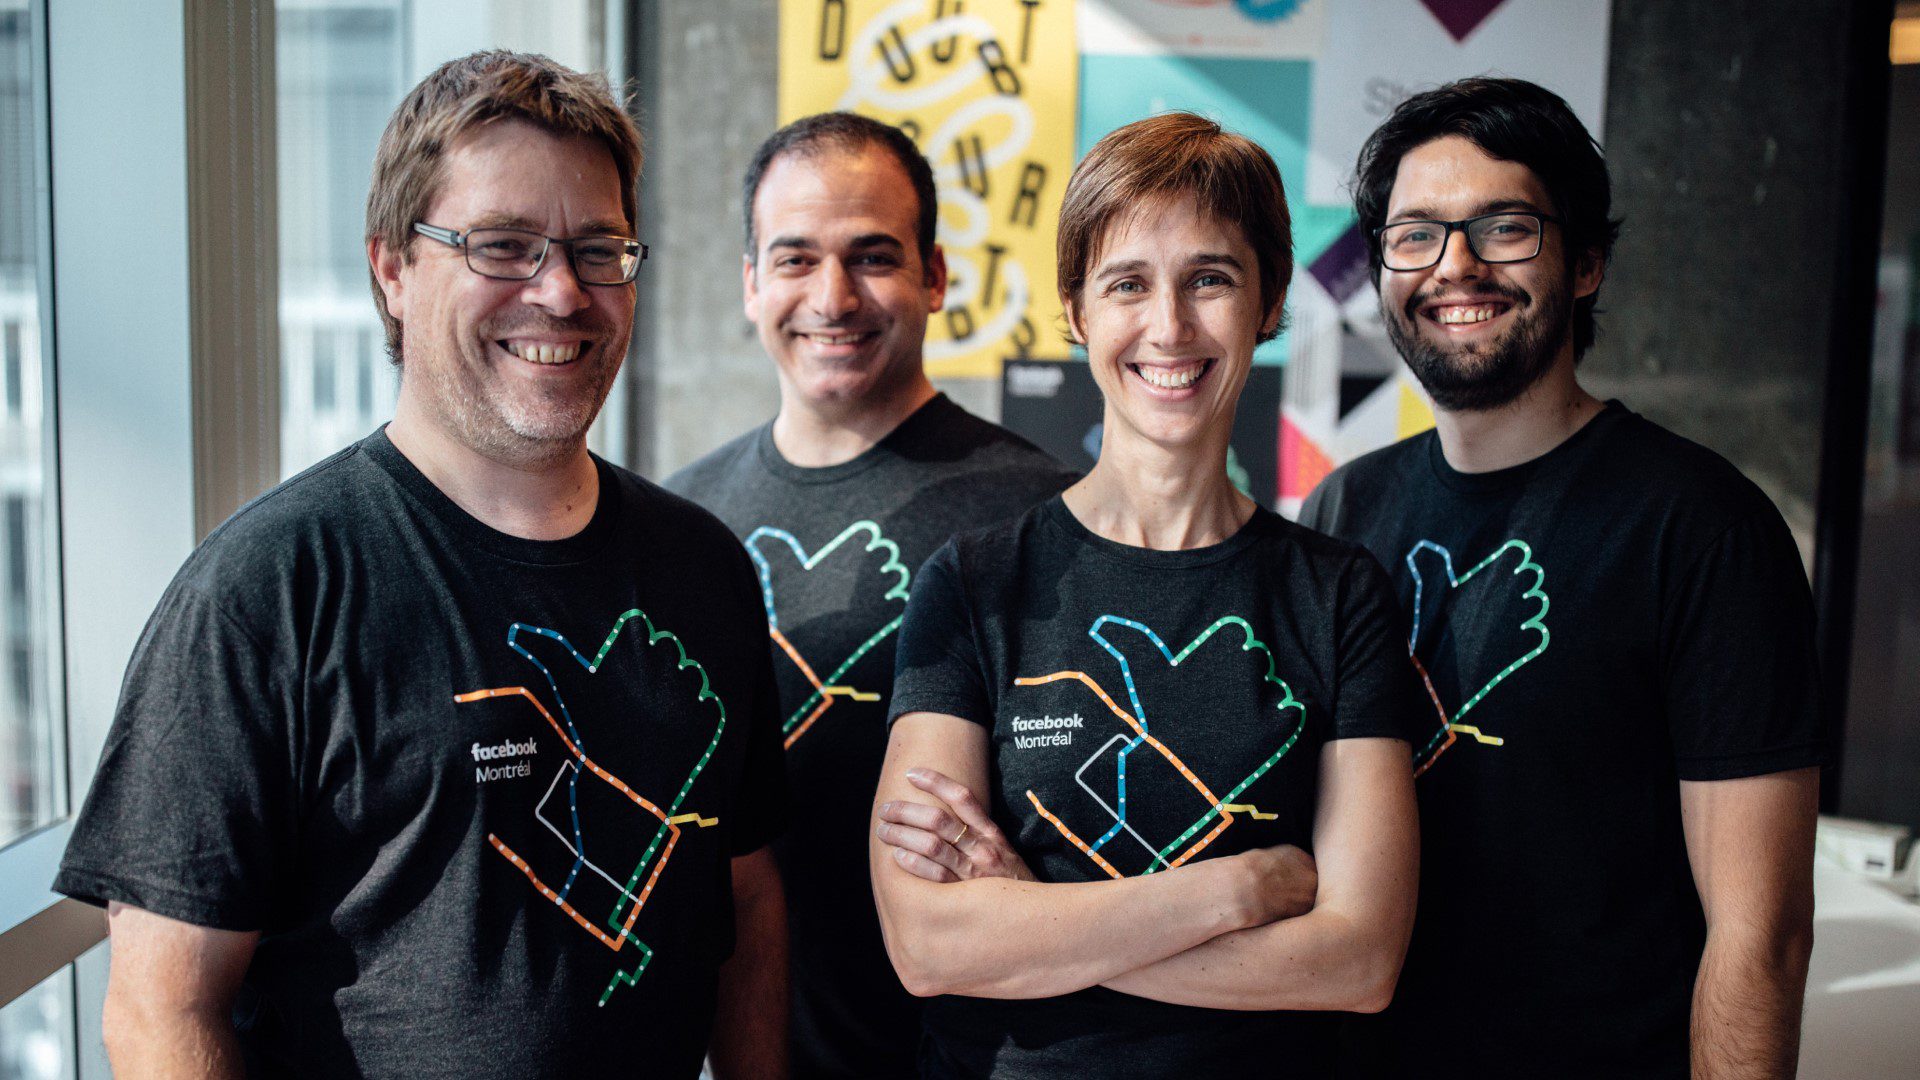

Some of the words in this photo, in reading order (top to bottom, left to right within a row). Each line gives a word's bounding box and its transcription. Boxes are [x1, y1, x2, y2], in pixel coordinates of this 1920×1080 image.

[1012, 713, 1084, 732] facebook
[471, 737, 537, 761] facebook
[1014, 731, 1072, 750] Montréal
[475, 759, 531, 783] Montréal
